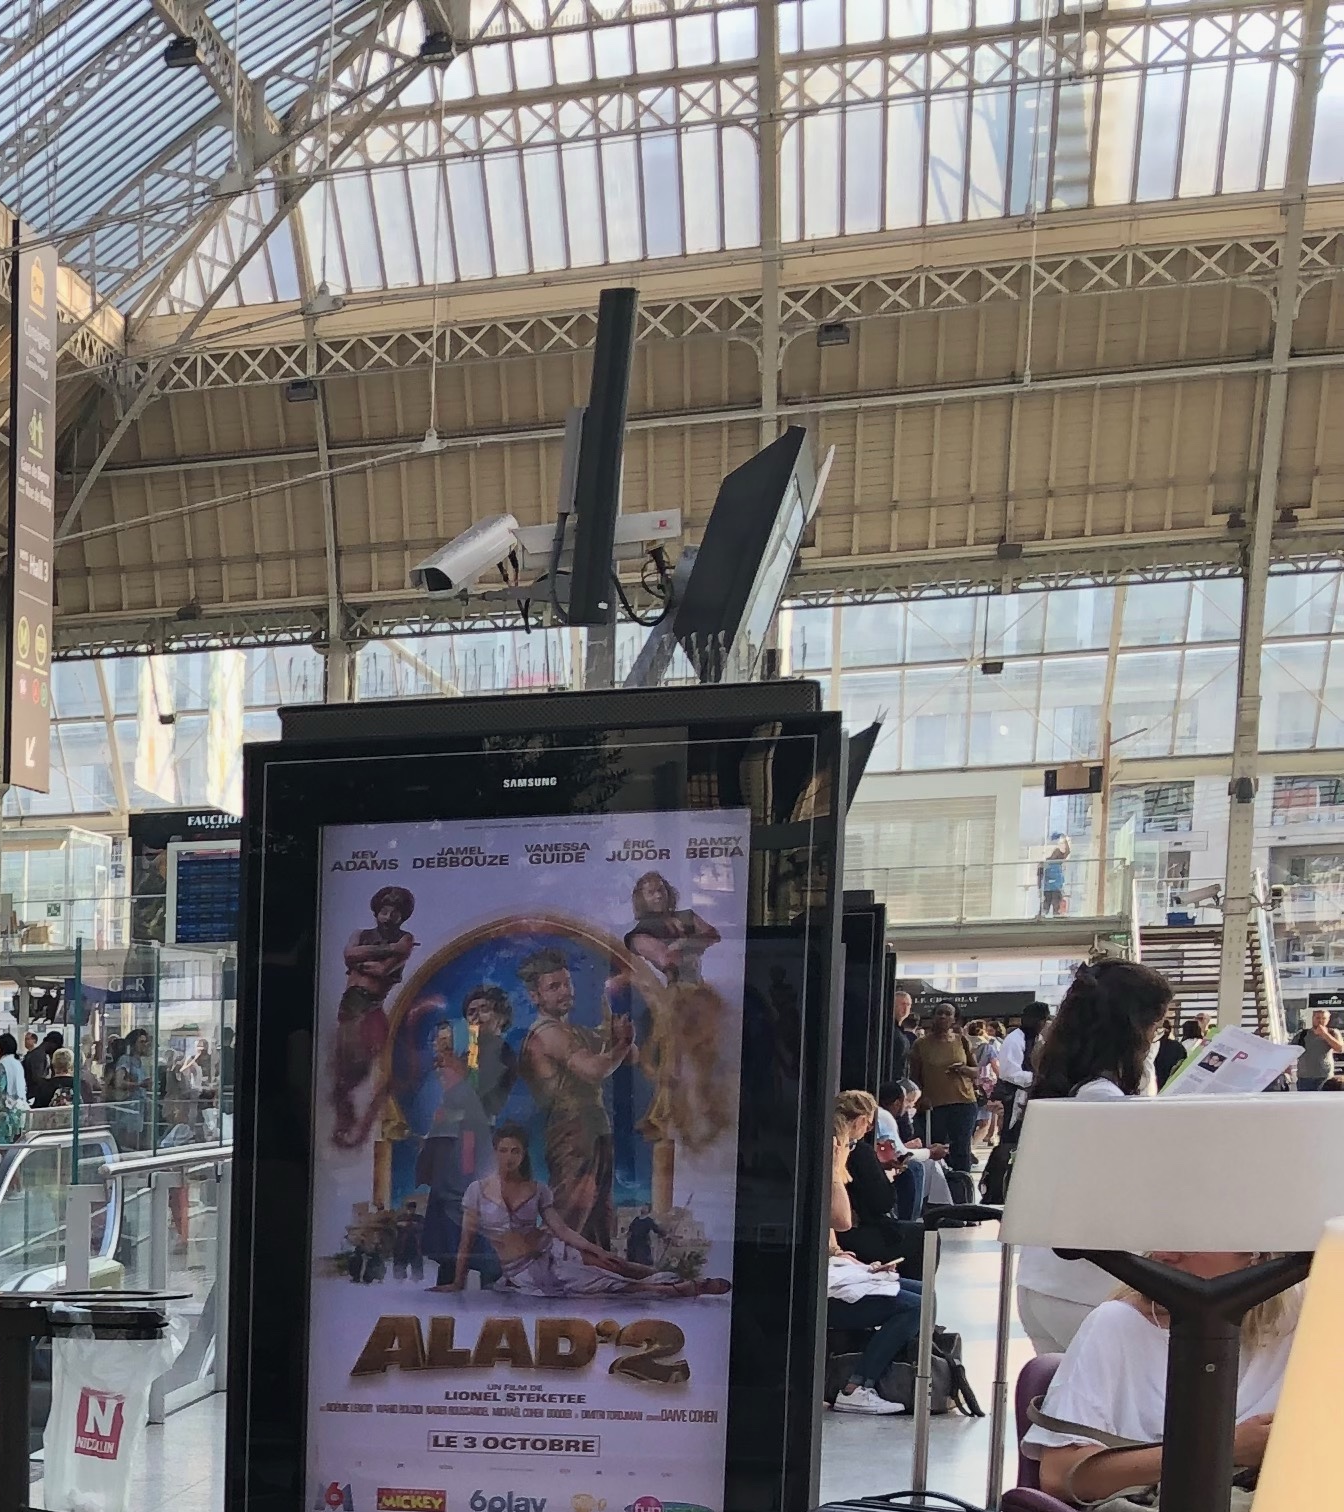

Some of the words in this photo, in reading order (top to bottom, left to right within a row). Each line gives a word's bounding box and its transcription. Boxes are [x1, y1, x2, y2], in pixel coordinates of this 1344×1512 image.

[503, 777, 557, 788] SAMSUNG
[351, 851, 379, 860] KEV
[436, 846, 485, 856] JAMEL
[524, 842, 591, 853] VANESSA
[623, 838, 655, 850] ÉRIC
[688, 836, 742, 847] RAMZY
[330, 858, 399, 872] ADAMS
[412, 854, 510, 869] DEBBOUZE
[528, 851, 586, 865] GUIDE
[605, 848, 671, 862] JUDOR
[685, 846, 744, 860] BEDIA
[929, 996, 979, 1004] CHOLAT
[487, 1383, 502, 1391] UN
[503, 1383, 528, 1391] FILM
[529, 1384, 543, 1392] DE
[444, 1391, 501, 1402] LIONEL
[505, 1392, 586, 1404] STEKETEE
[85, 1395, 118, 1436] N
[432, 1435, 458, 1448] LE
[463, 1436, 477, 1449] 3
[482, 1436, 595, 1453] OCTOBRE
[379, 1494, 443, 1510] MICKEY
